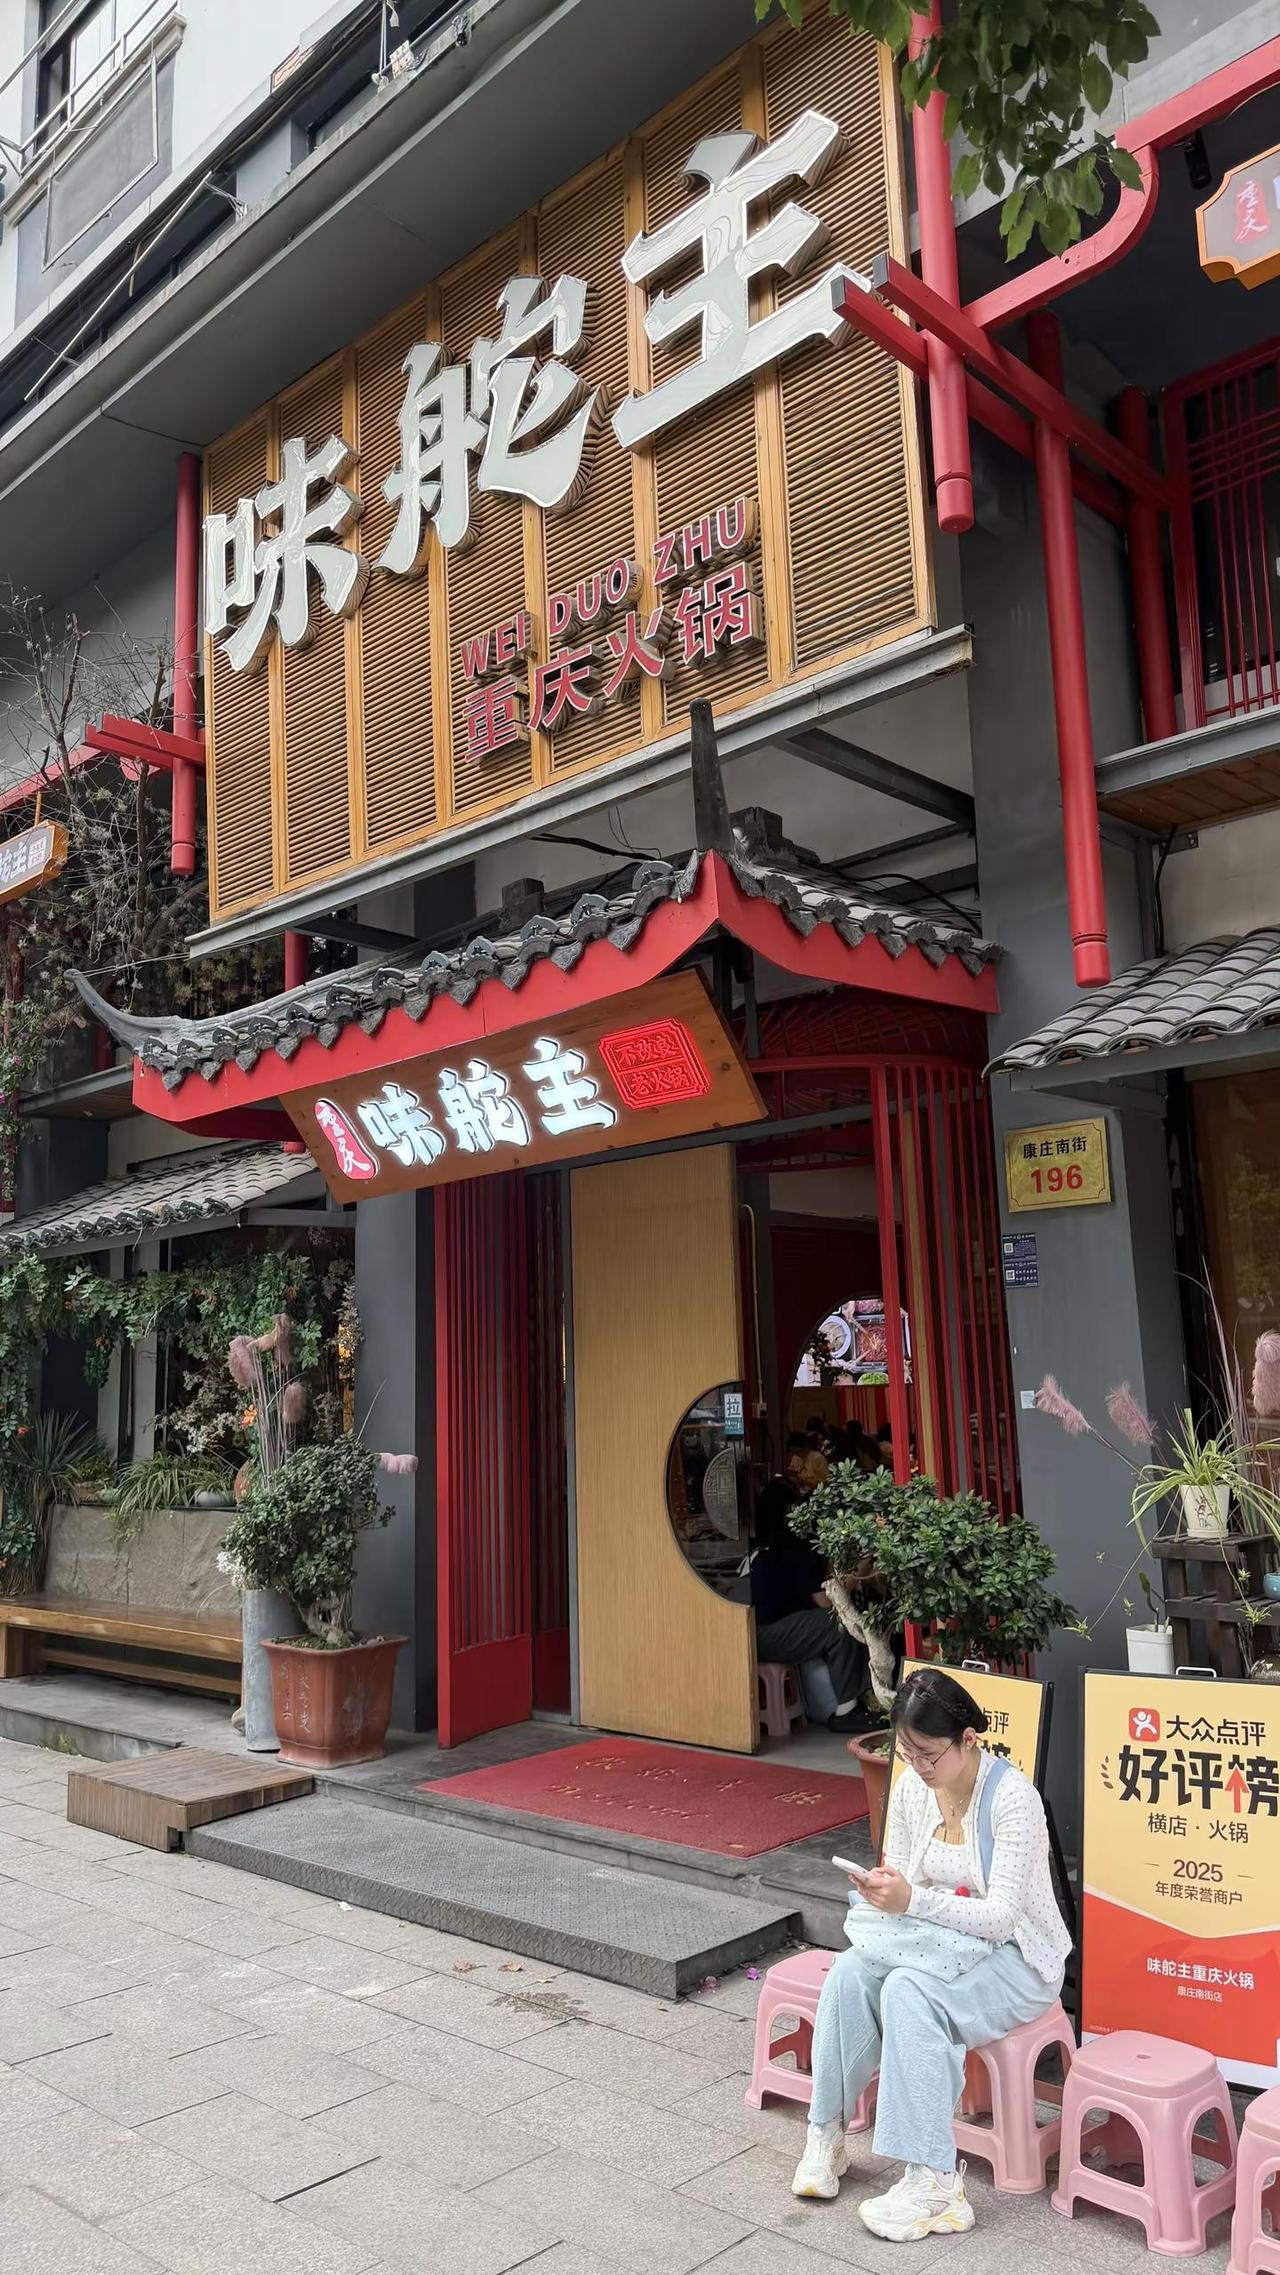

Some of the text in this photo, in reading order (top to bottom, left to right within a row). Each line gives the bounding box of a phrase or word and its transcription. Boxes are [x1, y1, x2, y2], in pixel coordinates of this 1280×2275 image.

[203, 110, 874, 673] 味舵主
[461, 496, 747, 680] WEI DUO ZHU
[463, 561, 752, 762] 重庆火锅
[631, 1064, 692, 1096] 老火锅
[357, 1036, 618, 1168] 味舵主
[1023, 1136, 1087, 1159] 康庄南街
[1030, 1164, 1083, 1193] 196
[726, 1397, 741, 1416] 拉
[1166, 1715, 1266, 1746] 大众点评
[1118, 1744, 1280, 1817] 好评榜
[1173, 1859, 1224, 1883] 2025
[1155, 1881, 1243, 1906] 年度荣誉商户
[1147, 1957, 1255, 1991] 味舵主重庆火锅
[1177, 1985, 1223, 2002] 康庄南街店
